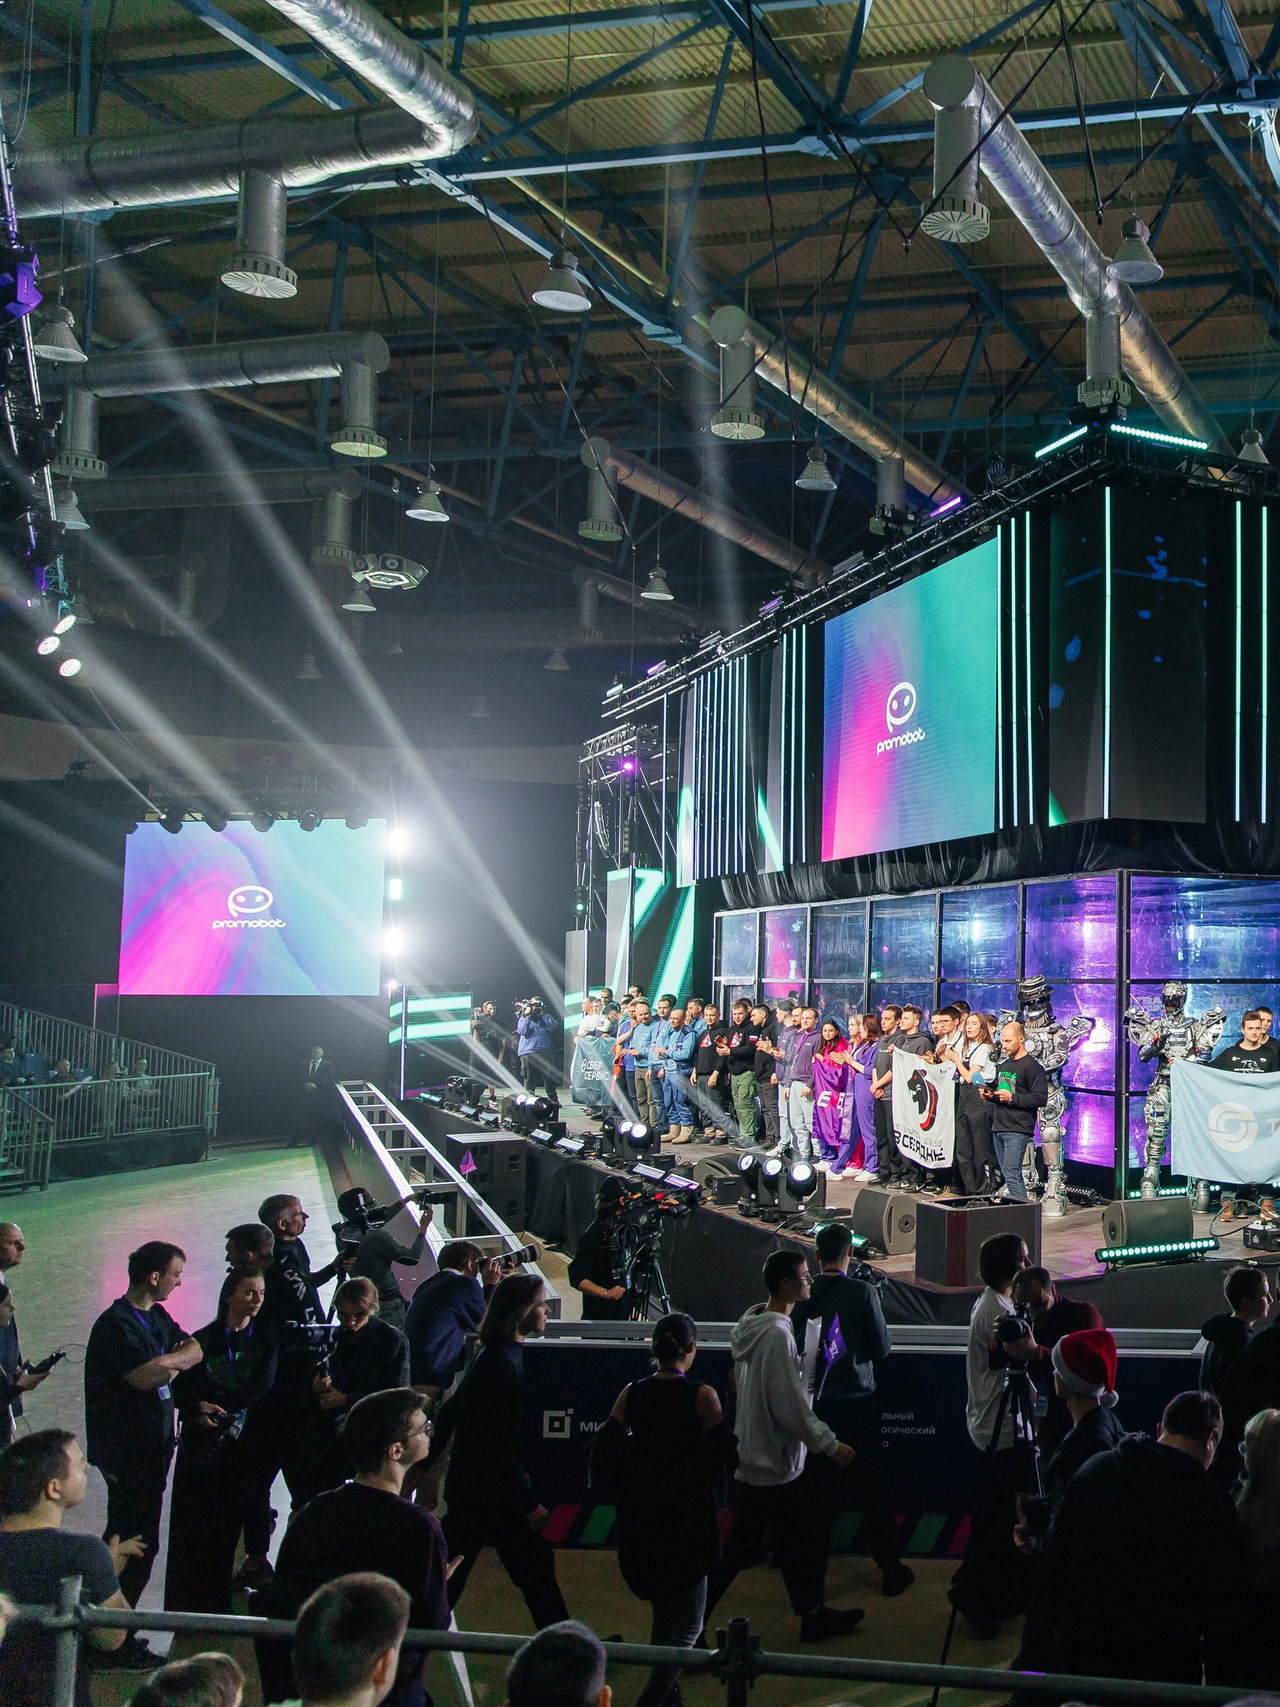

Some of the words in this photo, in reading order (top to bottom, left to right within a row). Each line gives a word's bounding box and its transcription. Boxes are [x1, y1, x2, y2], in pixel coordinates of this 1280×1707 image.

[876, 726, 926, 756] promobot
[212, 918, 286, 930] promobot
[584, 1071, 610, 1081] СЕРВИС
[881, 1410, 915, 1420] льный
[880, 1424, 936, 1435] огический
